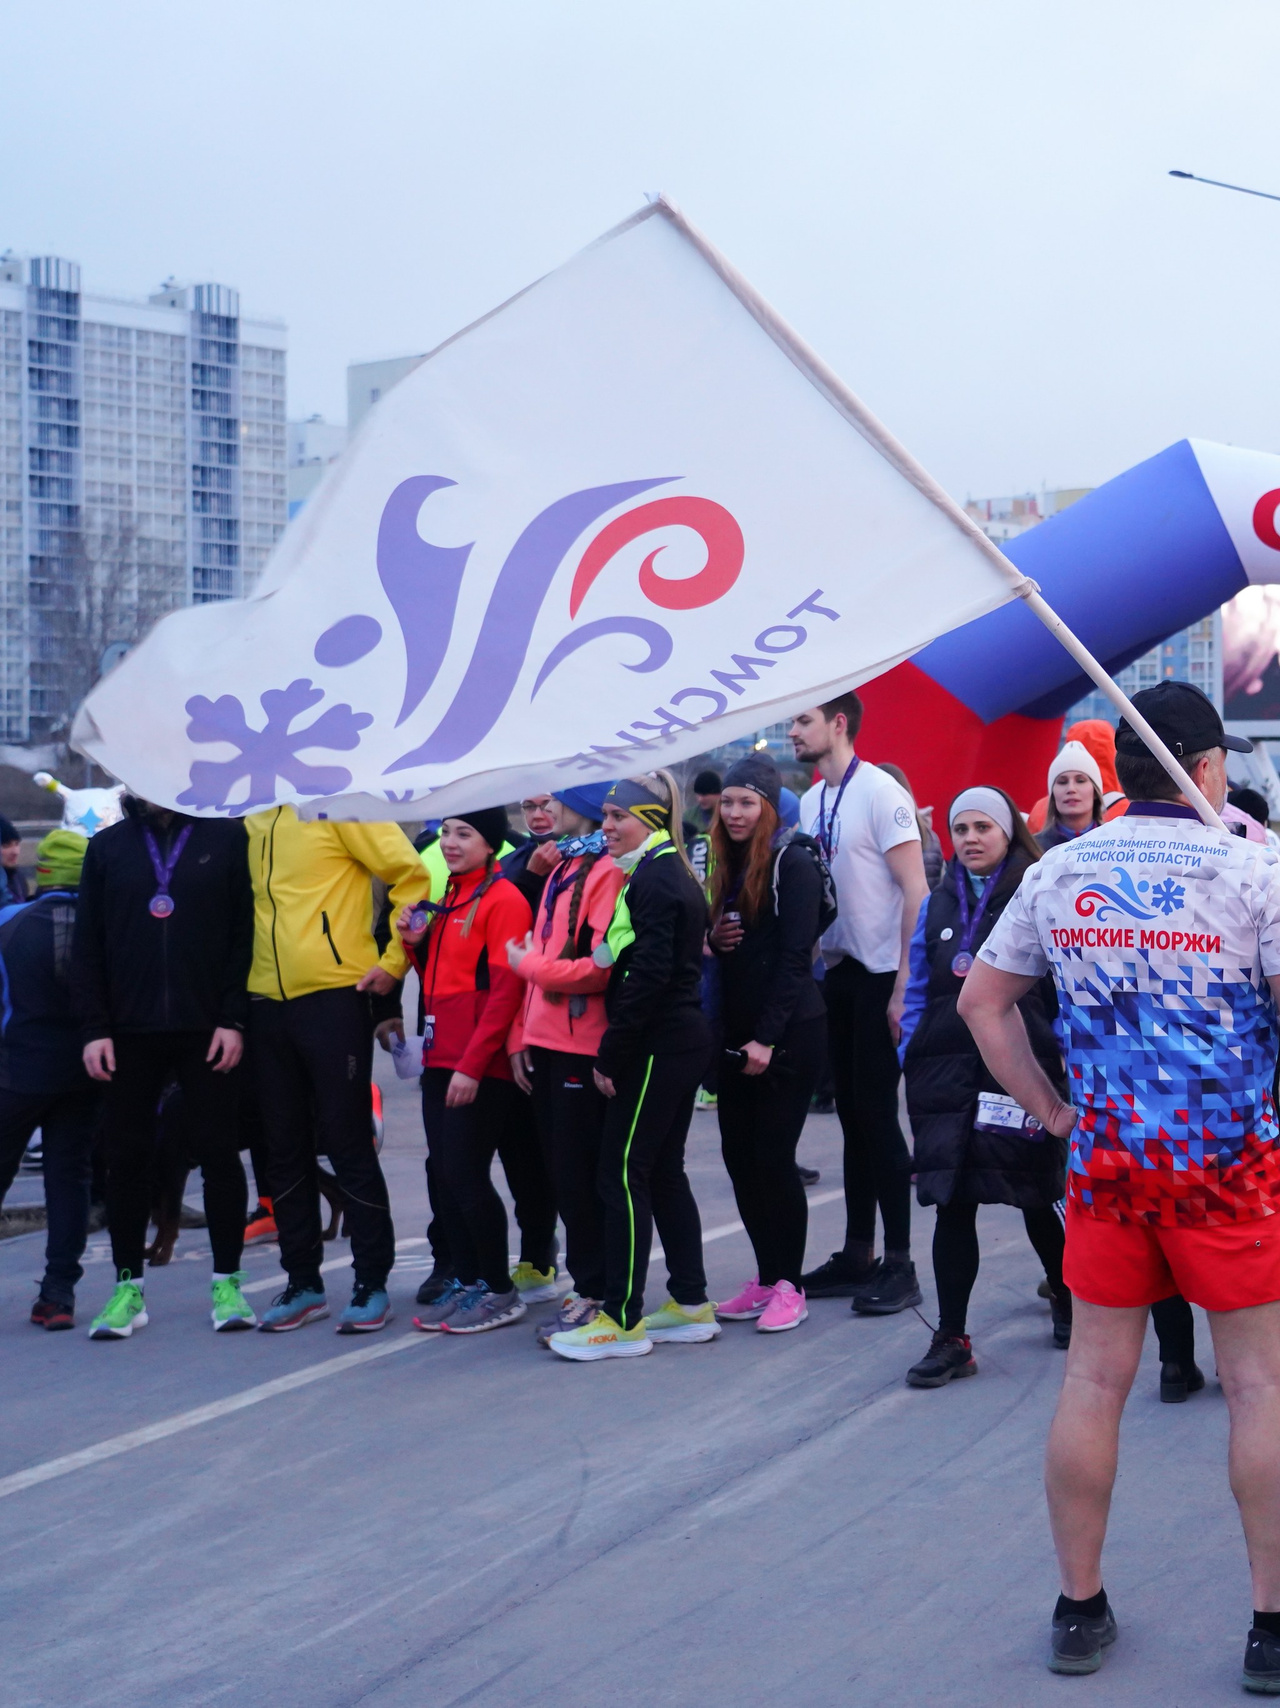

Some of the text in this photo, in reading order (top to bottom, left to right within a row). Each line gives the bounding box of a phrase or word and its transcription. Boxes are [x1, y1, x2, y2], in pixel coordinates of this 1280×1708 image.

[1064, 839, 1229, 857] ФЕДЕРАЦИЯ ЗИМНЕГО ПЛАВАНИЯ
[1076, 849, 1201, 867] ТОМСКОЙ ОБЛАСТИ
[1050, 927, 1221, 953] ТОМСКИЕ МОРЖИ
[587, 1333, 618, 1345] HOKA
